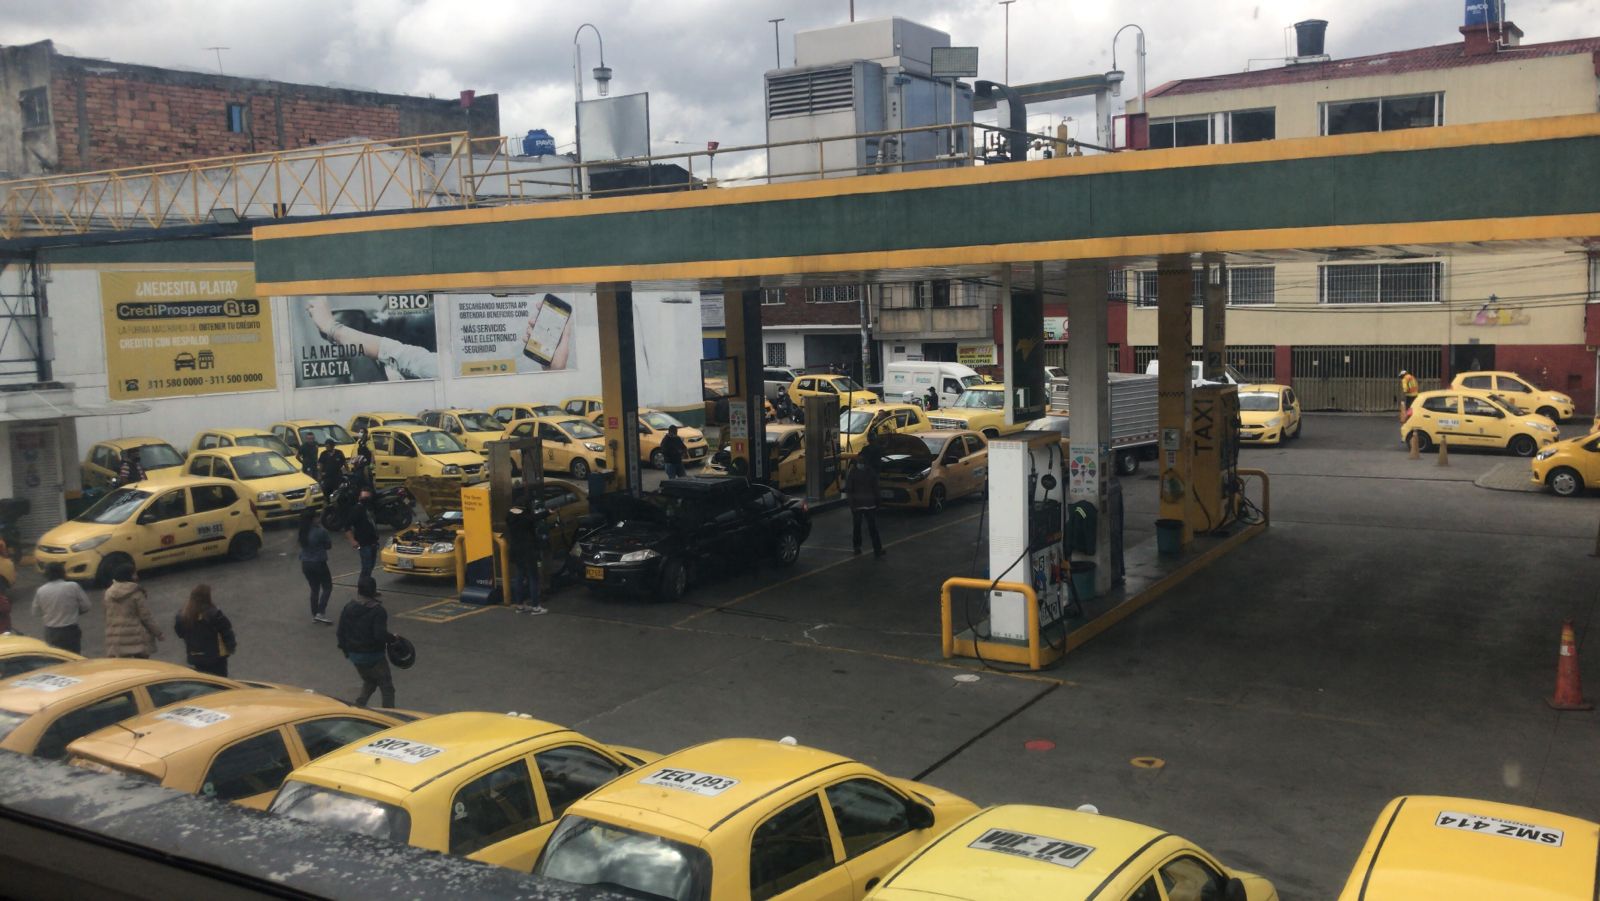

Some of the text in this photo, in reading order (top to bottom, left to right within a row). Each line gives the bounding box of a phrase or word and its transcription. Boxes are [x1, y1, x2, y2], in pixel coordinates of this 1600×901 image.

[136, 280, 238, 297] ¿NECESITA PLATA?
[388, 294, 428, 310] BRIO
[458, 303, 495, 311] DESCARGANDO
[496, 302, 517, 310] NUESTRA
[487, 310, 514, 318] BENEFICIOS
[198, 322, 226, 331] OBTENER
[227, 322, 235, 330] TU
[477, 323, 506, 333] SERVICIOS
[119, 338, 154, 349] CREDITO
[155, 336, 171, 347] CON
[172, 335, 210, 346] RESPALDO
[479, 333, 517, 343] ELECTRONICO
[302, 343, 365, 360] LA MEDIDA
[303, 360, 350, 377] EXACTA
[148, 380, 164, 390] 311
[166, 379, 182, 388] 580
[183, 377, 204, 387] 0000
[210, 376, 225, 385] 311
[227, 375, 242, 384] 500
[243, 373, 263, 383] 0000
[1016, 387, 1025, 408] 1
[1194, 400, 1214, 456] TAXI
[652, 768, 734, 790] TEQ 093
[1440, 816, 1559, 843] SMZ 414
[980, 830, 1037, 848] VDF
[1036, 841, 1089, 859] 170
